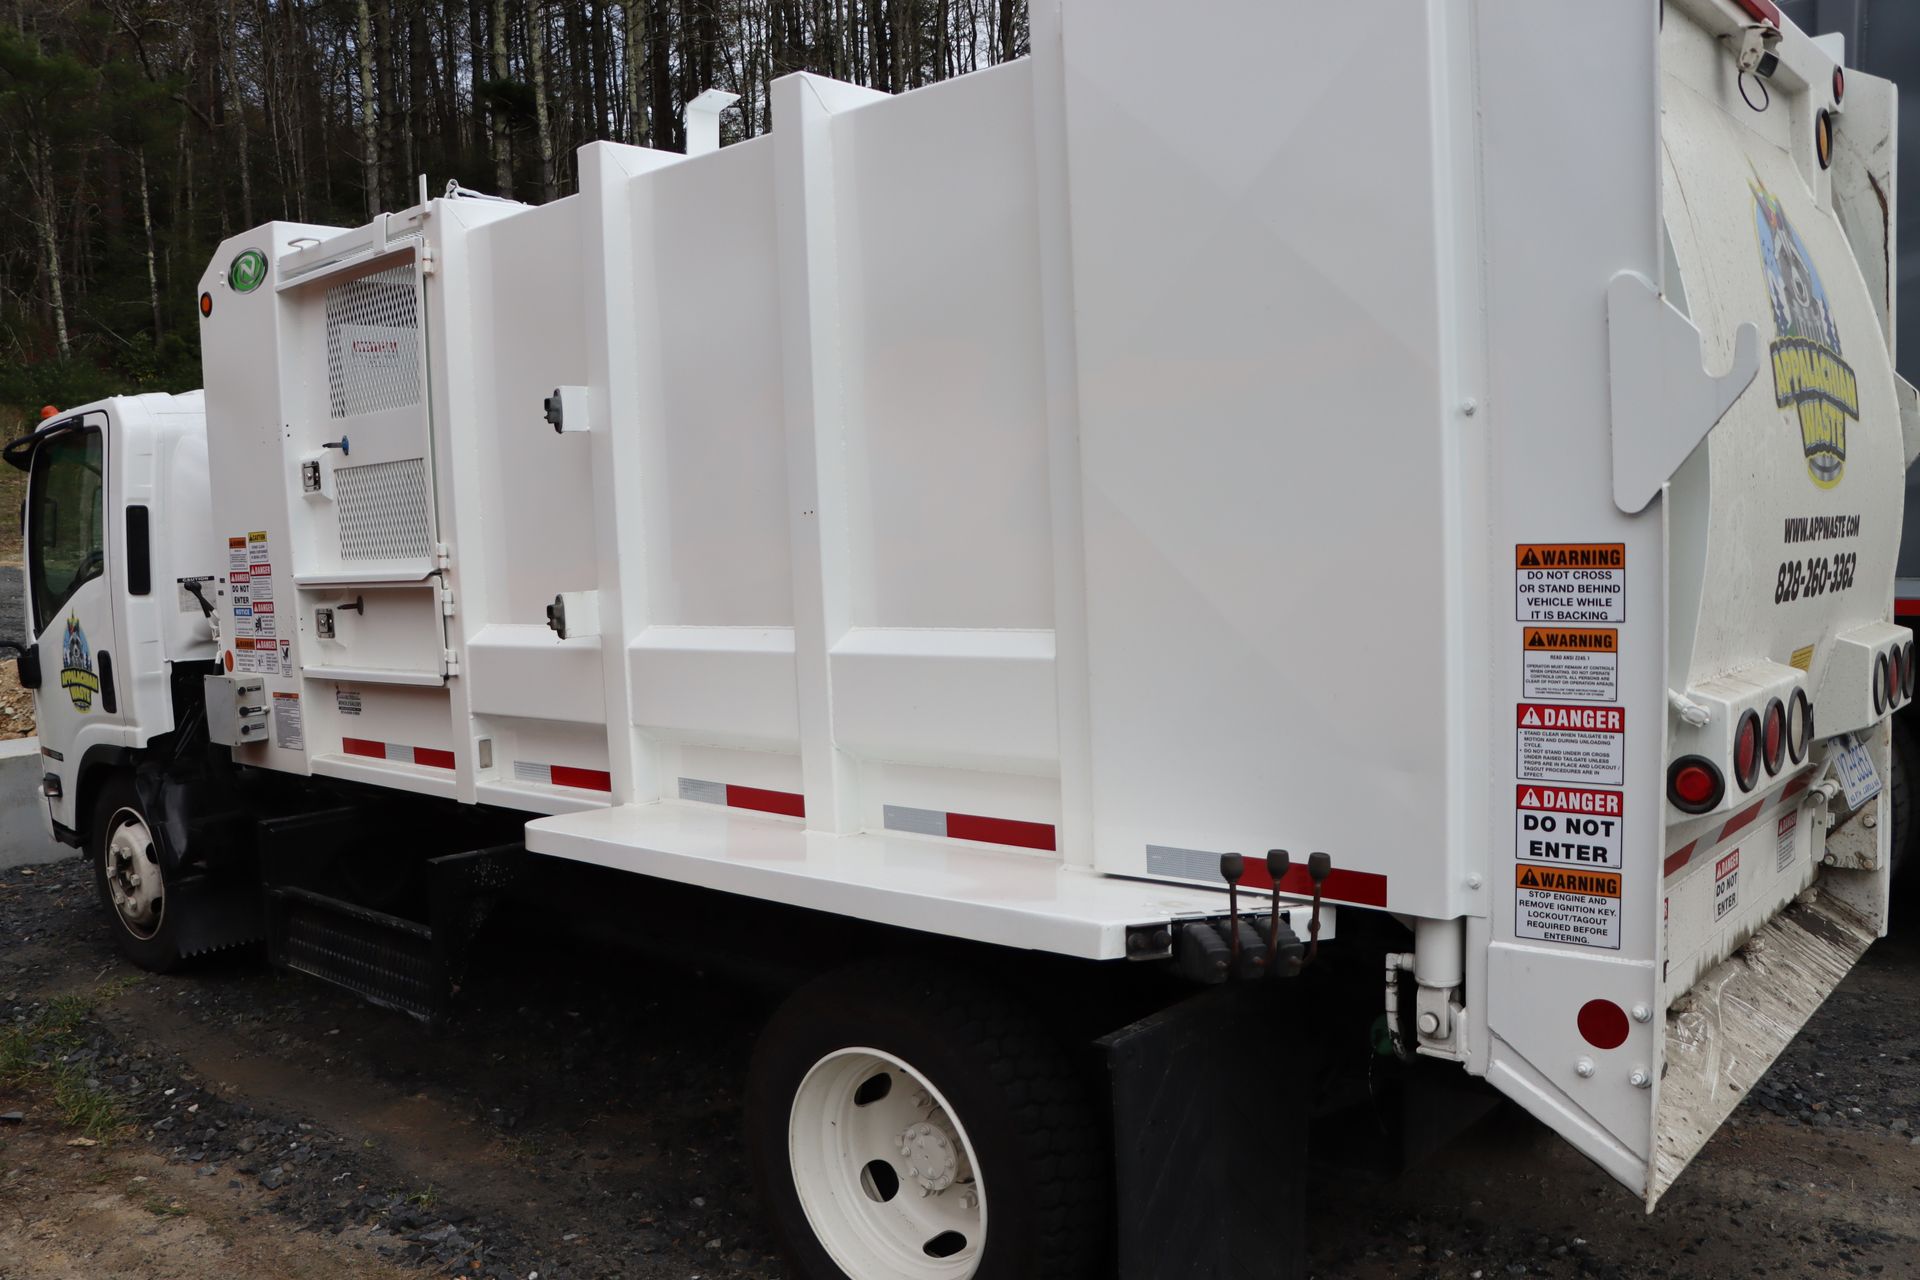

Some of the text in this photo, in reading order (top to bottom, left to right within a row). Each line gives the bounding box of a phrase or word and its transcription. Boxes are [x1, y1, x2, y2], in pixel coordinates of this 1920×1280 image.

[1772, 343, 1859, 416] APPALACHIAN
[1800, 399, 1846, 453] WASTE
[1542, 550, 1620, 565] WARNING
[1528, 571, 1612, 580] DO NOT CROSS
[1775, 552, 1856, 605] 828-260-3362
[1520, 584, 1620, 594] OR STAND BEHIND
[1527, 597, 1612, 607] VEHICLE WHILE
[1531, 610, 1540, 619] IT
[1544, 611, 1554, 619] IS
[1558, 611, 1608, 620] BACKING
[1546, 634, 1612, 648] WARNING
[1544, 708, 1620, 729] DANGER
[1544, 790, 1618, 813] DANGER
[1524, 814, 1614, 838] DO NOT
[1530, 840, 1607, 863] ENTER
[1722, 852, 1739, 875] DANGER
[1540, 872, 1616, 894] WARNING
[1716, 873, 1737, 897] DO NOT
[1529, 891, 1606, 905] STOP ENGINE AND
[1717, 892, 1736, 916] ENTER
[1519, 899, 1616, 917] REMOVE IGNITION KEY.
[1528, 910, 1607, 926] LOCKOUT/TAGOUT
[1527, 920, 1608, 936] REQUIRED BEFORE
[1544, 932, 1590, 944] ENTERING.
